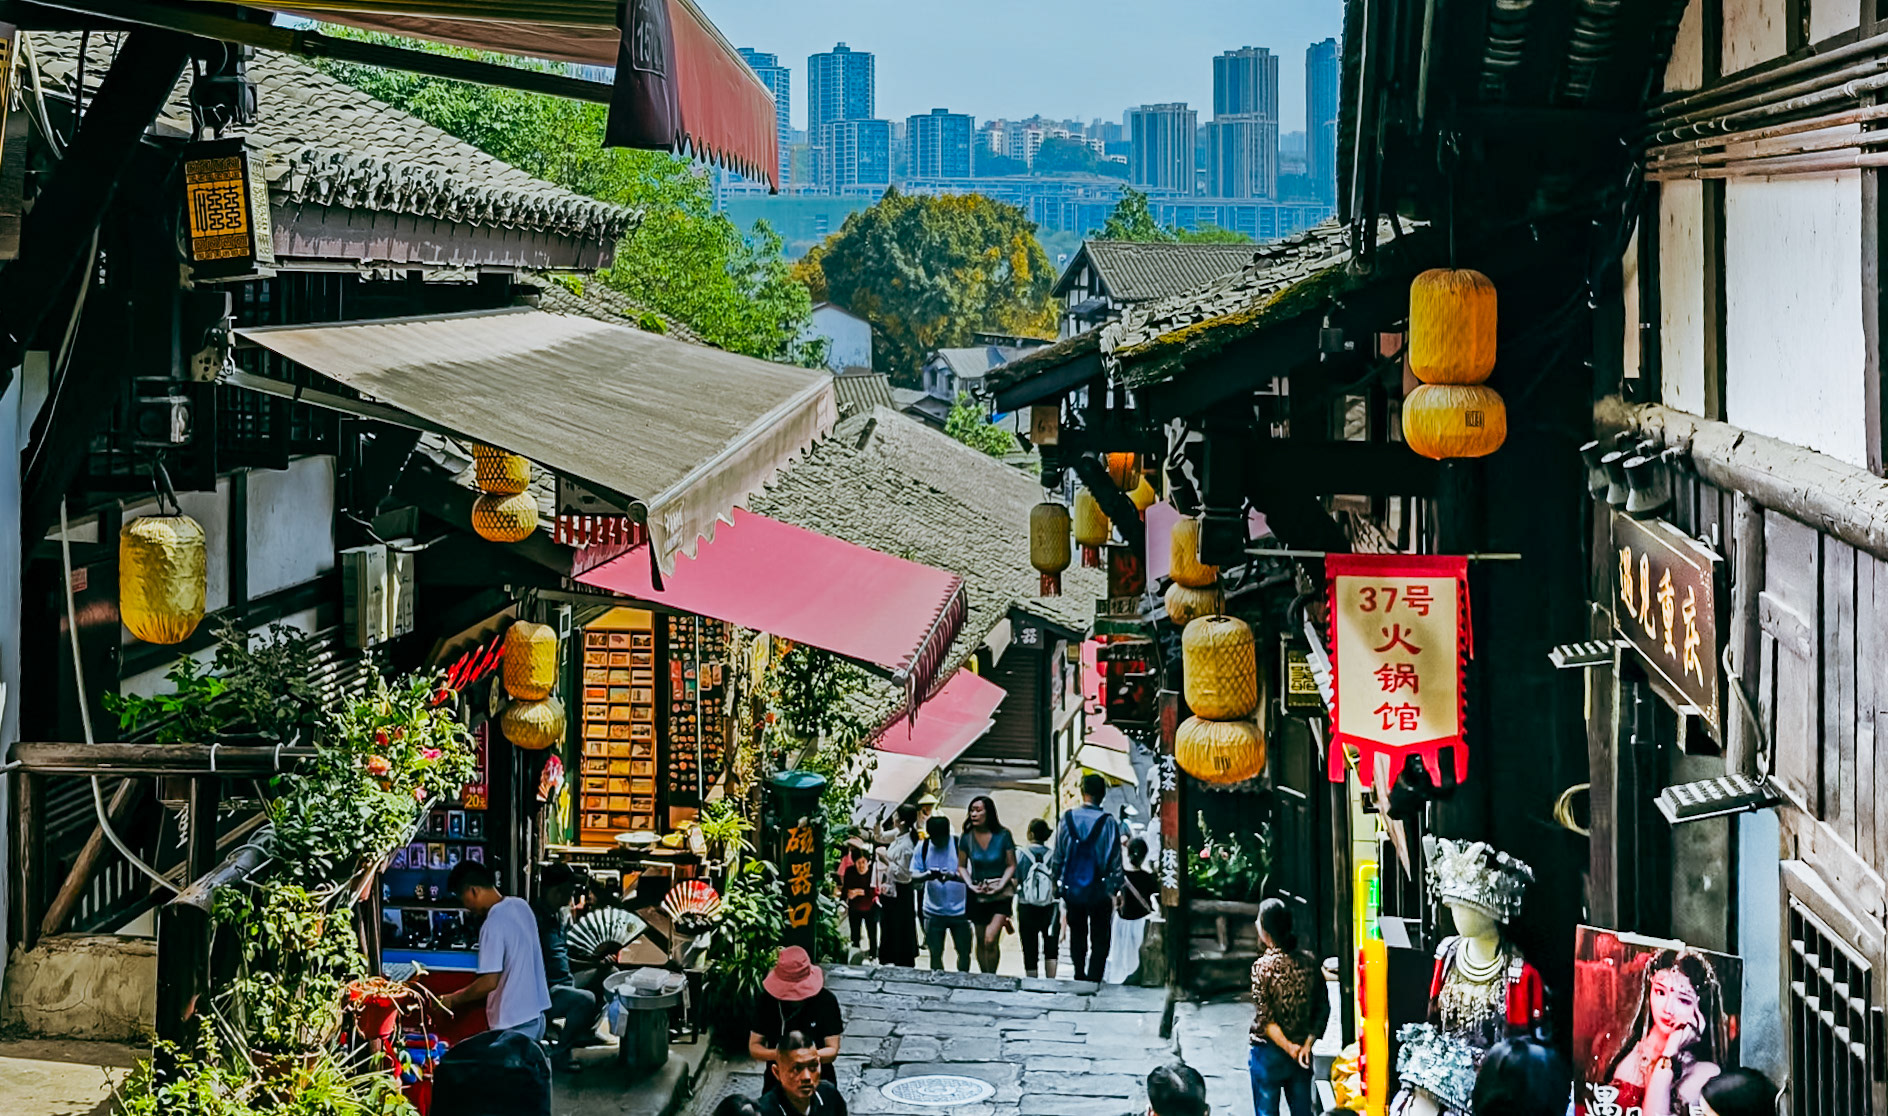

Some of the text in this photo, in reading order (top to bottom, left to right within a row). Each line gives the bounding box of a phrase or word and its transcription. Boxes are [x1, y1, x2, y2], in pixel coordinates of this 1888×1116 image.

[1359, 585, 1433, 617] 37号
[1373, 622, 1423, 732] 火锅馆
[785, 826, 815, 929] 磁器口
